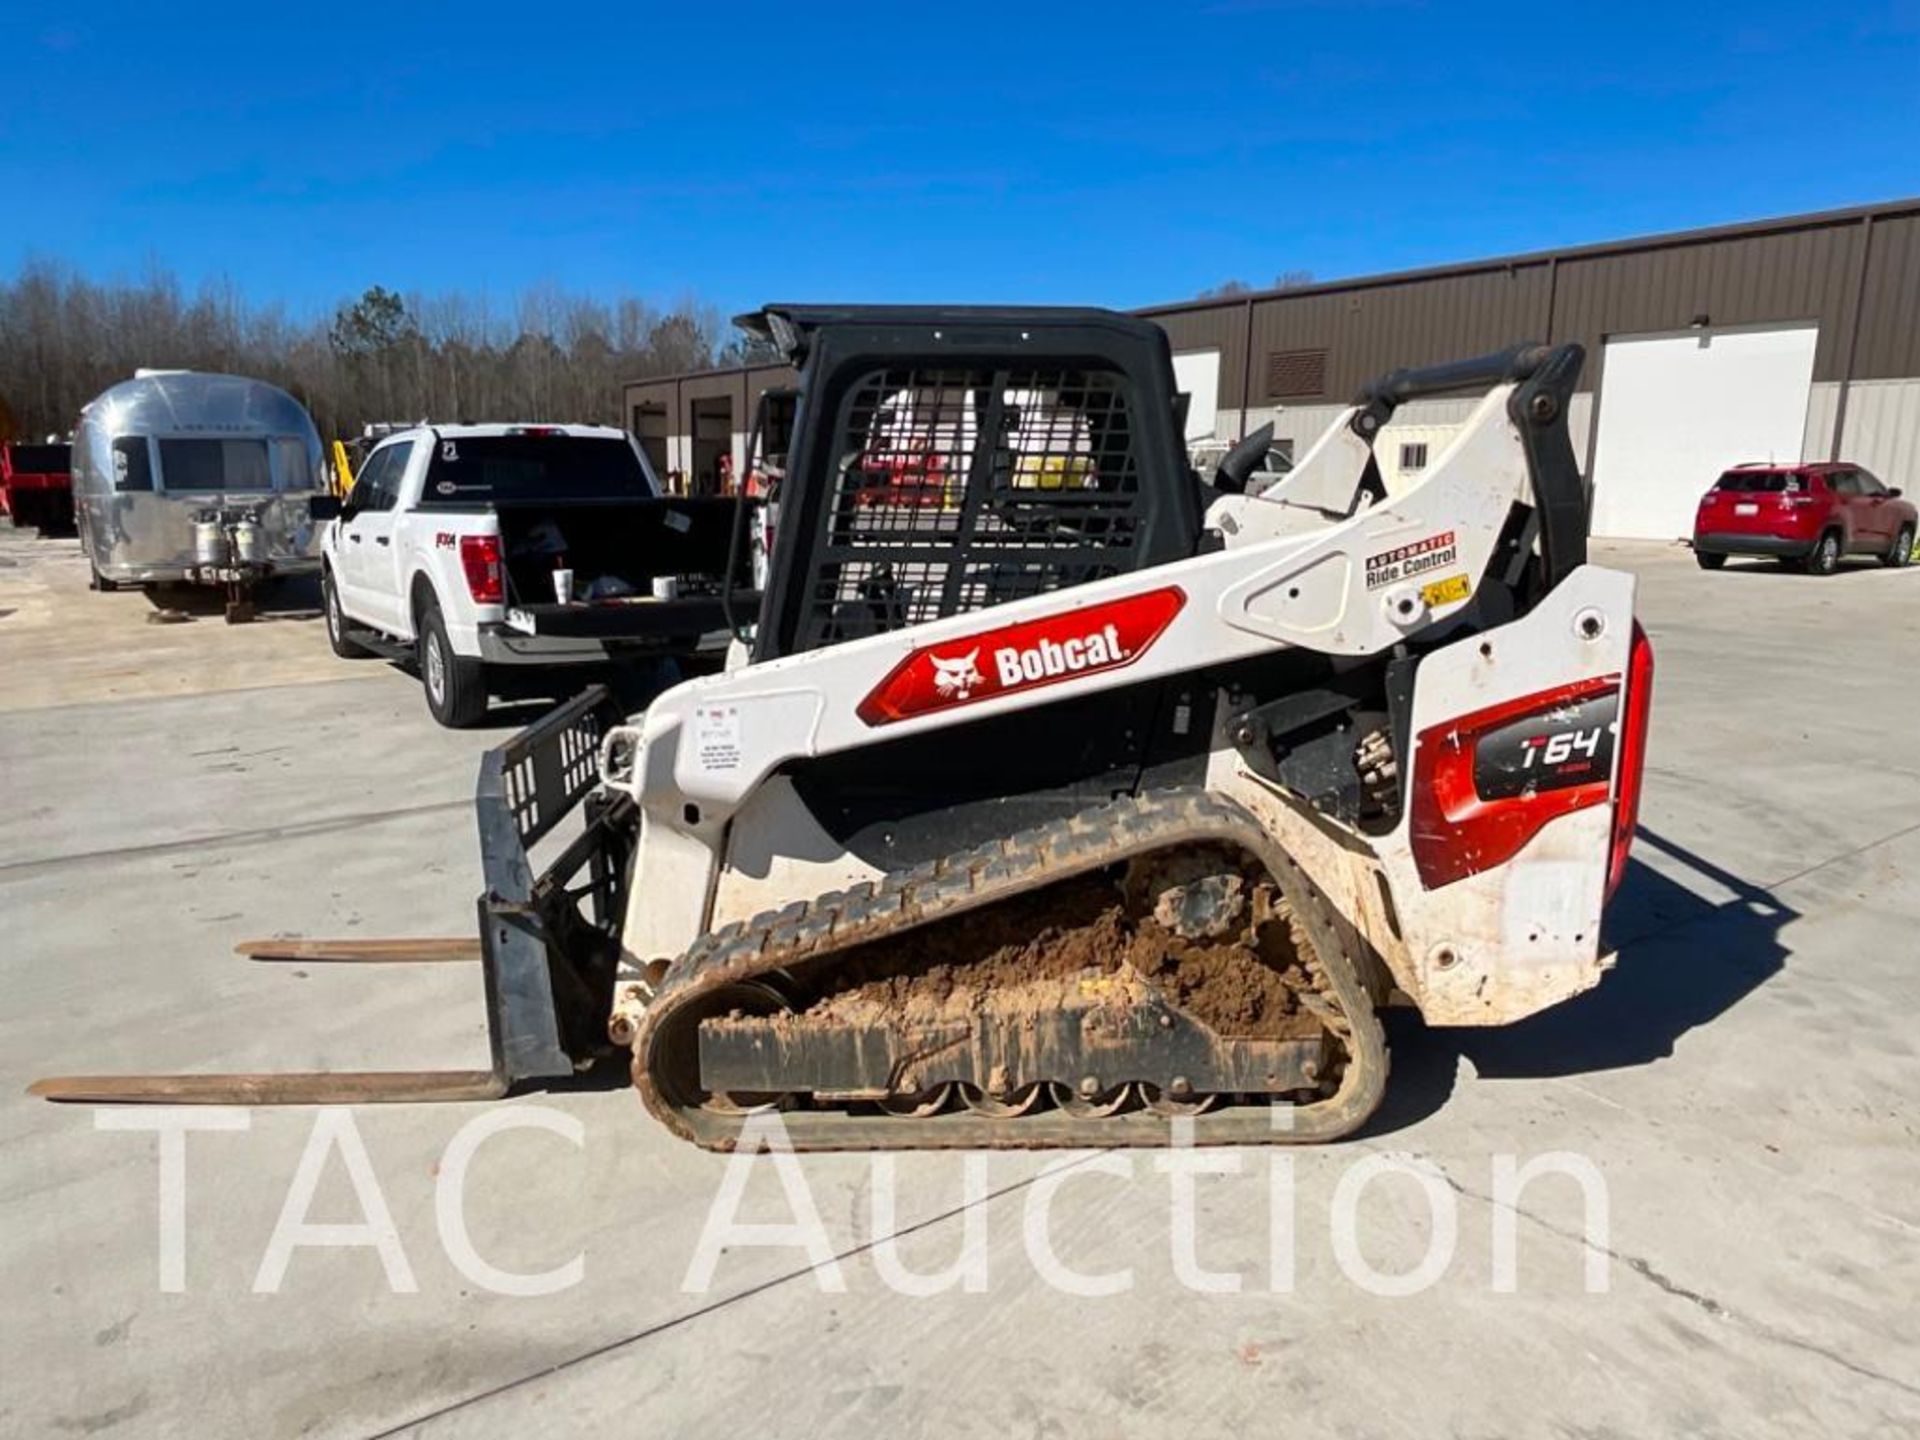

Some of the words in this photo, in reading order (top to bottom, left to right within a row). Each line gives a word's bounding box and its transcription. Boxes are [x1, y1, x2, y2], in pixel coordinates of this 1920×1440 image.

[1366, 568, 1399, 587] Ride
[1403, 546, 1456, 575] Control
[1368, 533, 1454, 570] AUTOMATIC
[994, 624, 1123, 687] Bobcat
[1521, 727, 1601, 769] T64
